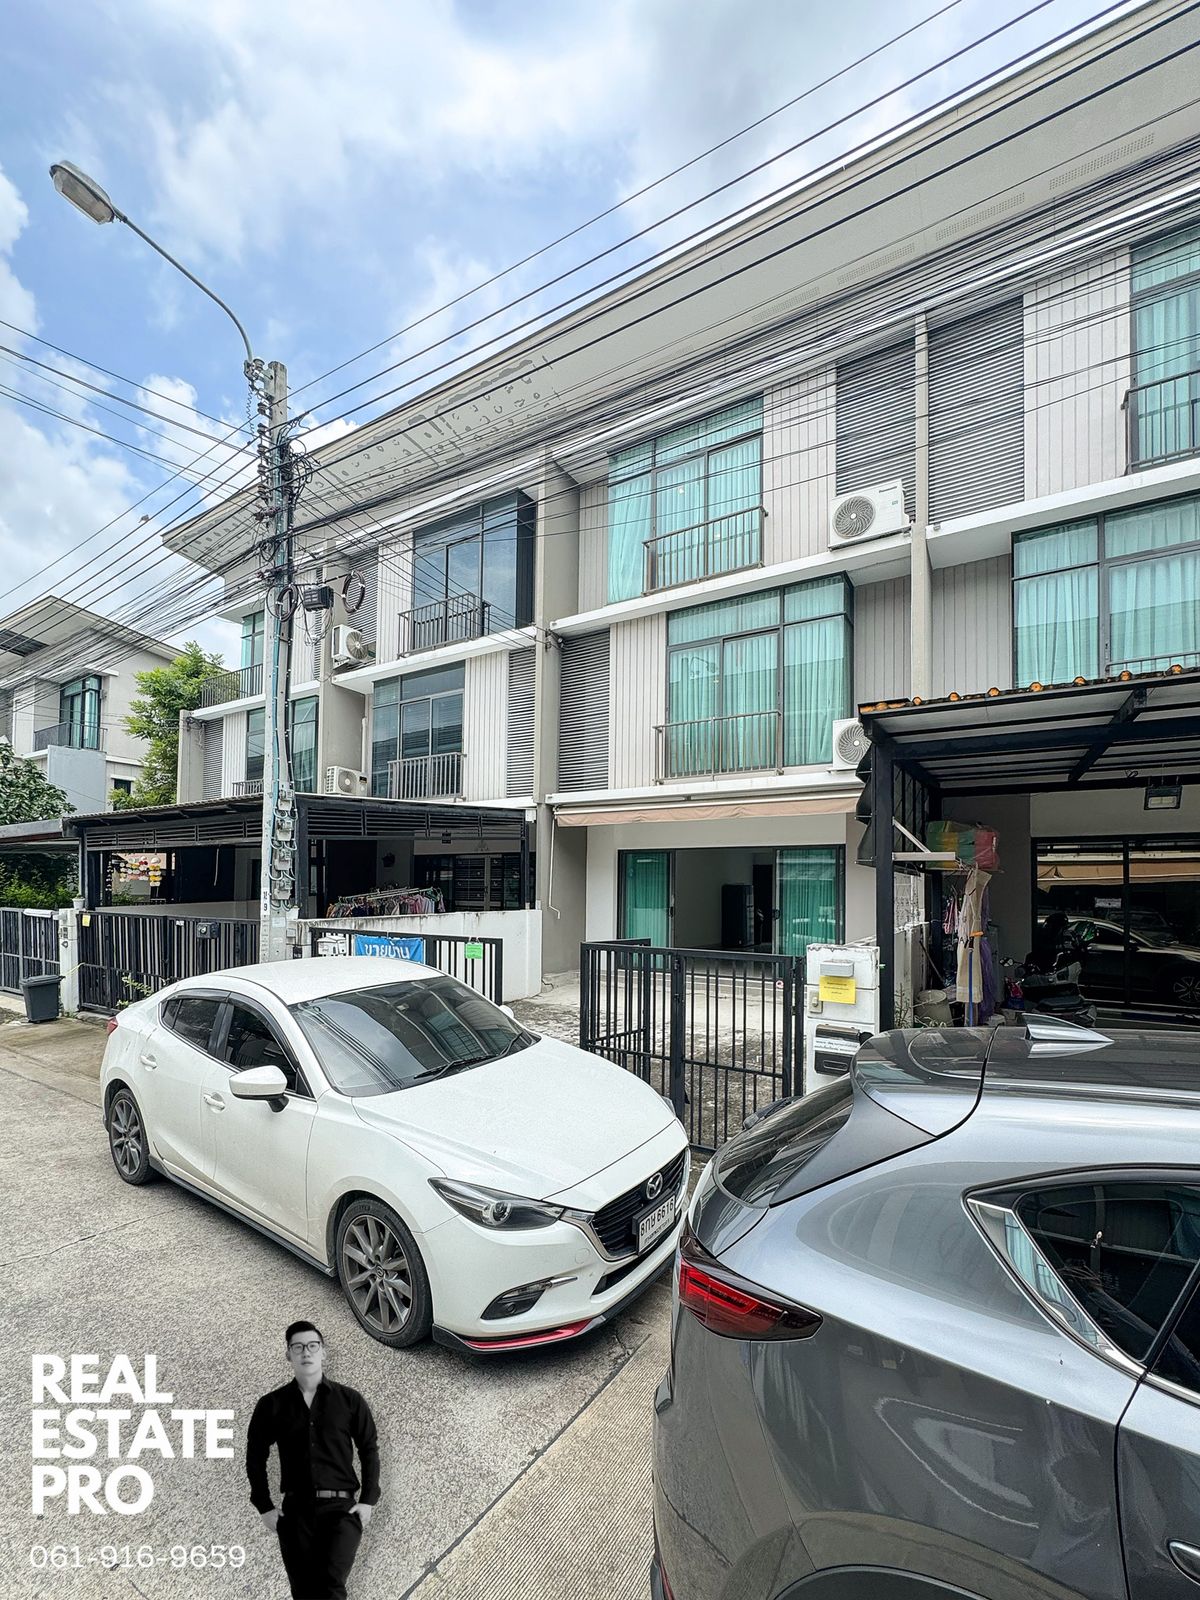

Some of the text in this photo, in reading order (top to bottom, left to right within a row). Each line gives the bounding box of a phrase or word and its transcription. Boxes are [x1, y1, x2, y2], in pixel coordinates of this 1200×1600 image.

[364, 941, 410, 959] ขายบ้าน
[657, 1198, 674, 1222] 6616
